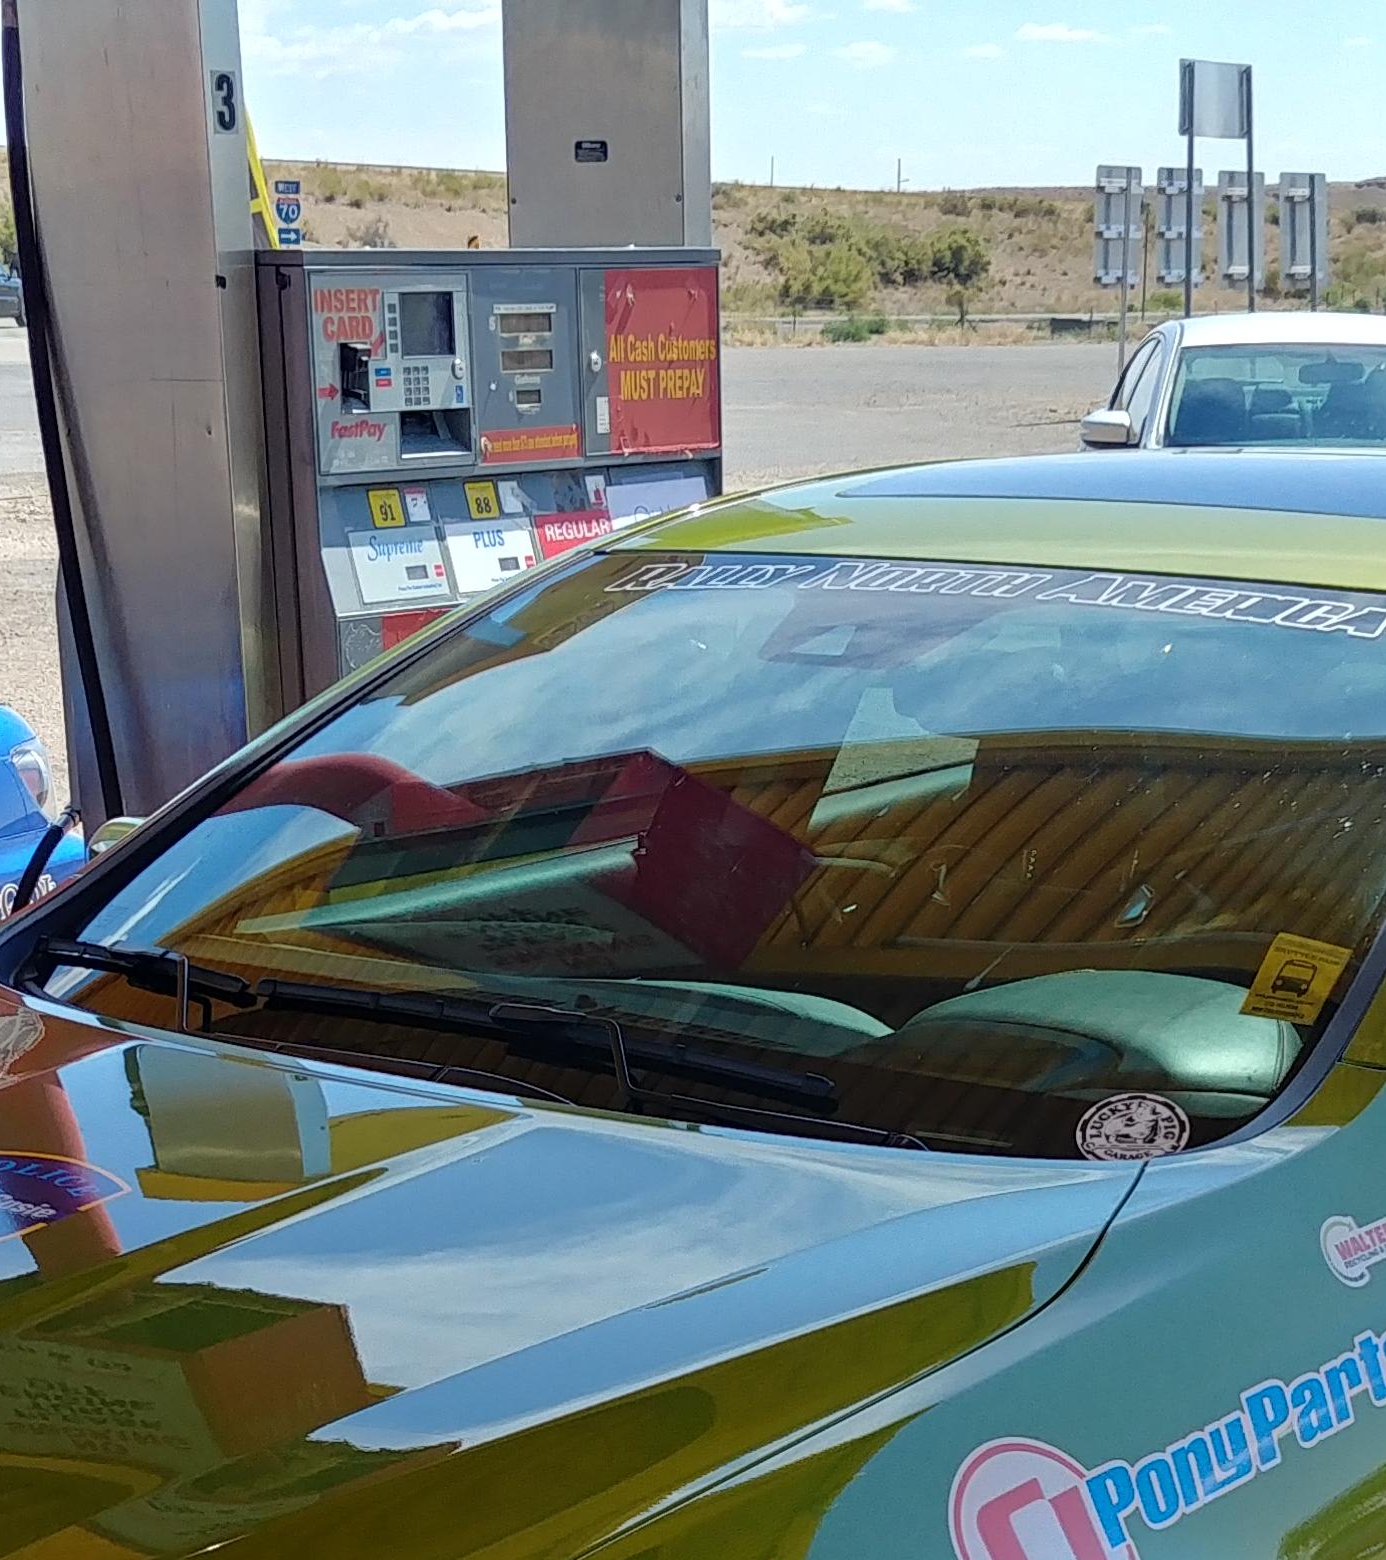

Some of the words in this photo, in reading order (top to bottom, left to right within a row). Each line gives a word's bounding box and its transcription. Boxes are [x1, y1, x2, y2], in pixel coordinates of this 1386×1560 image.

[215, 73, 235, 131] 3
[279, 204, 298, 220] 70
[314, 288, 380, 313] INSERT
[322, 315, 374, 343] CARD
[609, 334, 625, 364] All
[627, 333, 655, 363] Cash
[658, 332, 717, 363] Customers
[620, 369, 656, 401] MUST
[659, 367, 706, 399] PREPAY
[330, 419, 387, 442] FastPay
[379, 502, 397, 522] 91
[475, 496, 493, 514] 88
[473, 528, 506, 549] PLUS
[544, 518, 611, 543] REGULAR
[367, 535, 424, 562] Supreme
[1089, 1101, 1135, 1140] LUCKY
[1160, 1115, 1179, 1141] PIG
